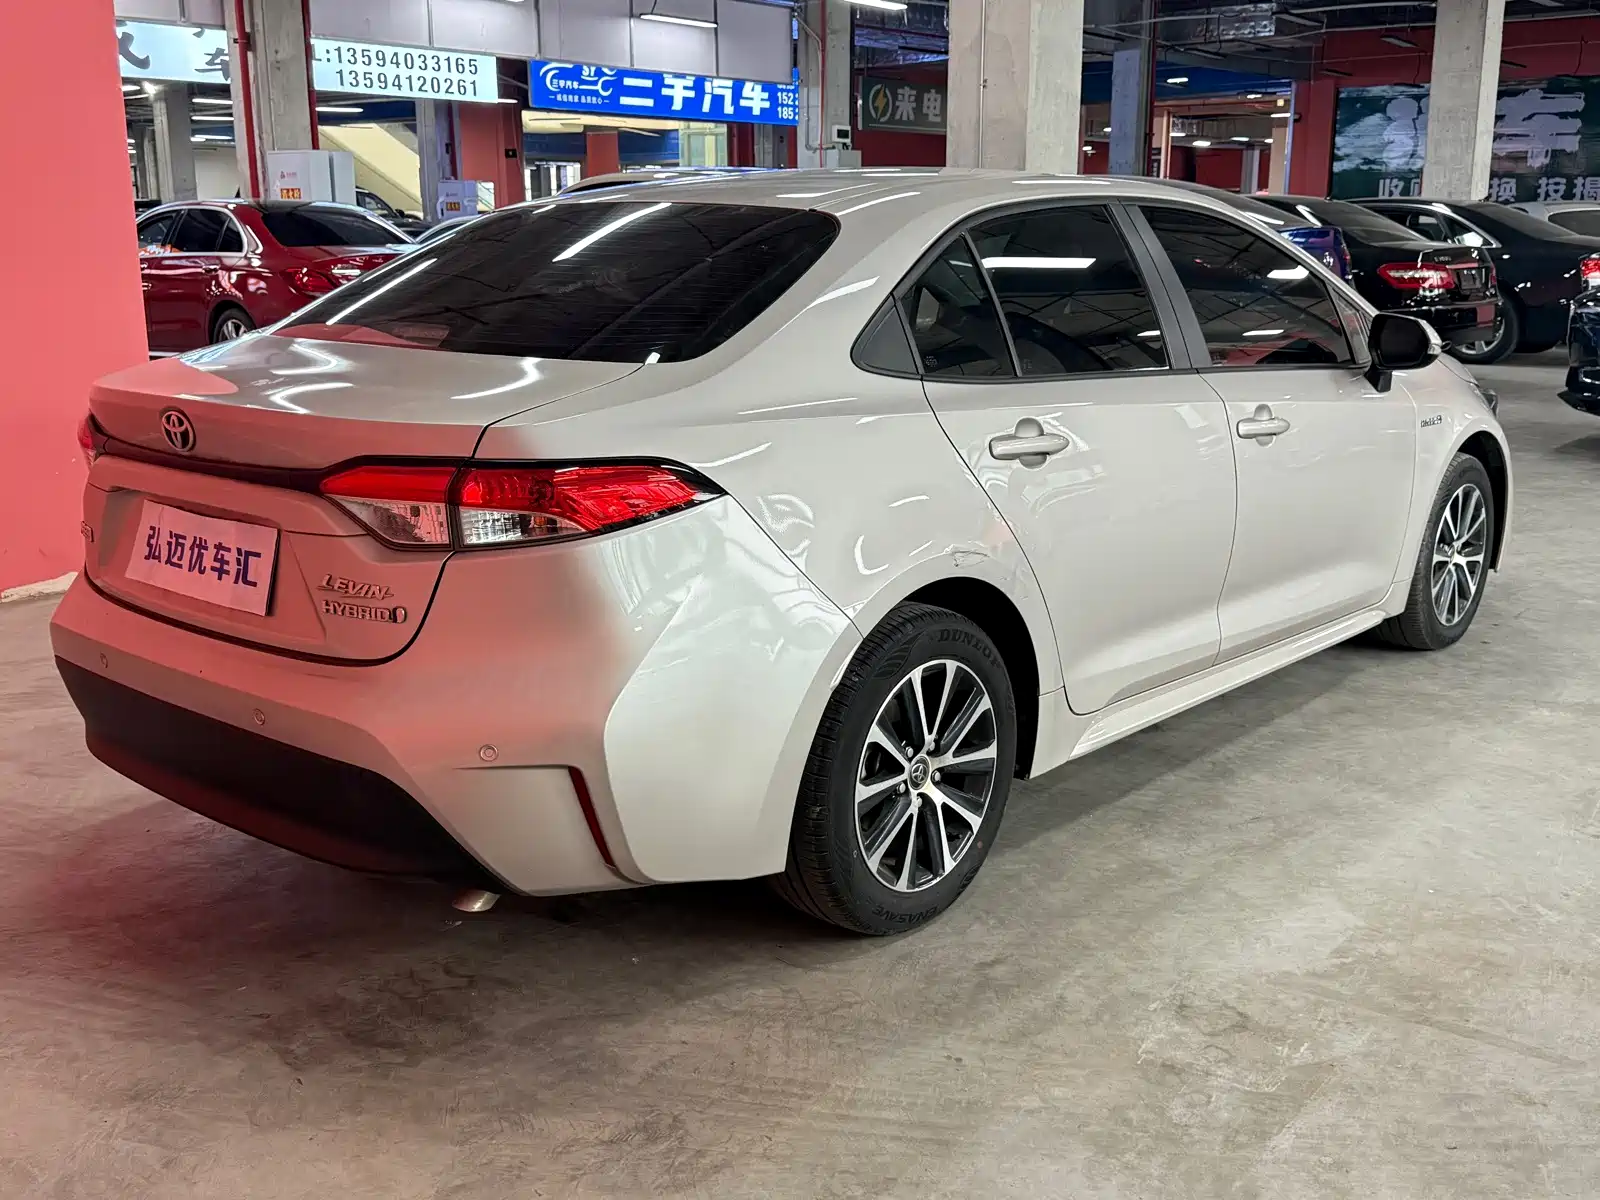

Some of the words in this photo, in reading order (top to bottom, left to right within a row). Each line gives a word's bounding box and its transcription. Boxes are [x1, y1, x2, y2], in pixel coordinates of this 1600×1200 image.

[336, 69, 477, 97] 13594120261
[894, 86, 942, 122] 来电
[143, 525, 262, 588] 弘迈优车汇
[317, 573, 394, 601] LEVIN
[321, 600, 393, 623] HYBRID
[938, 628, 1002, 668] DUNLOP
